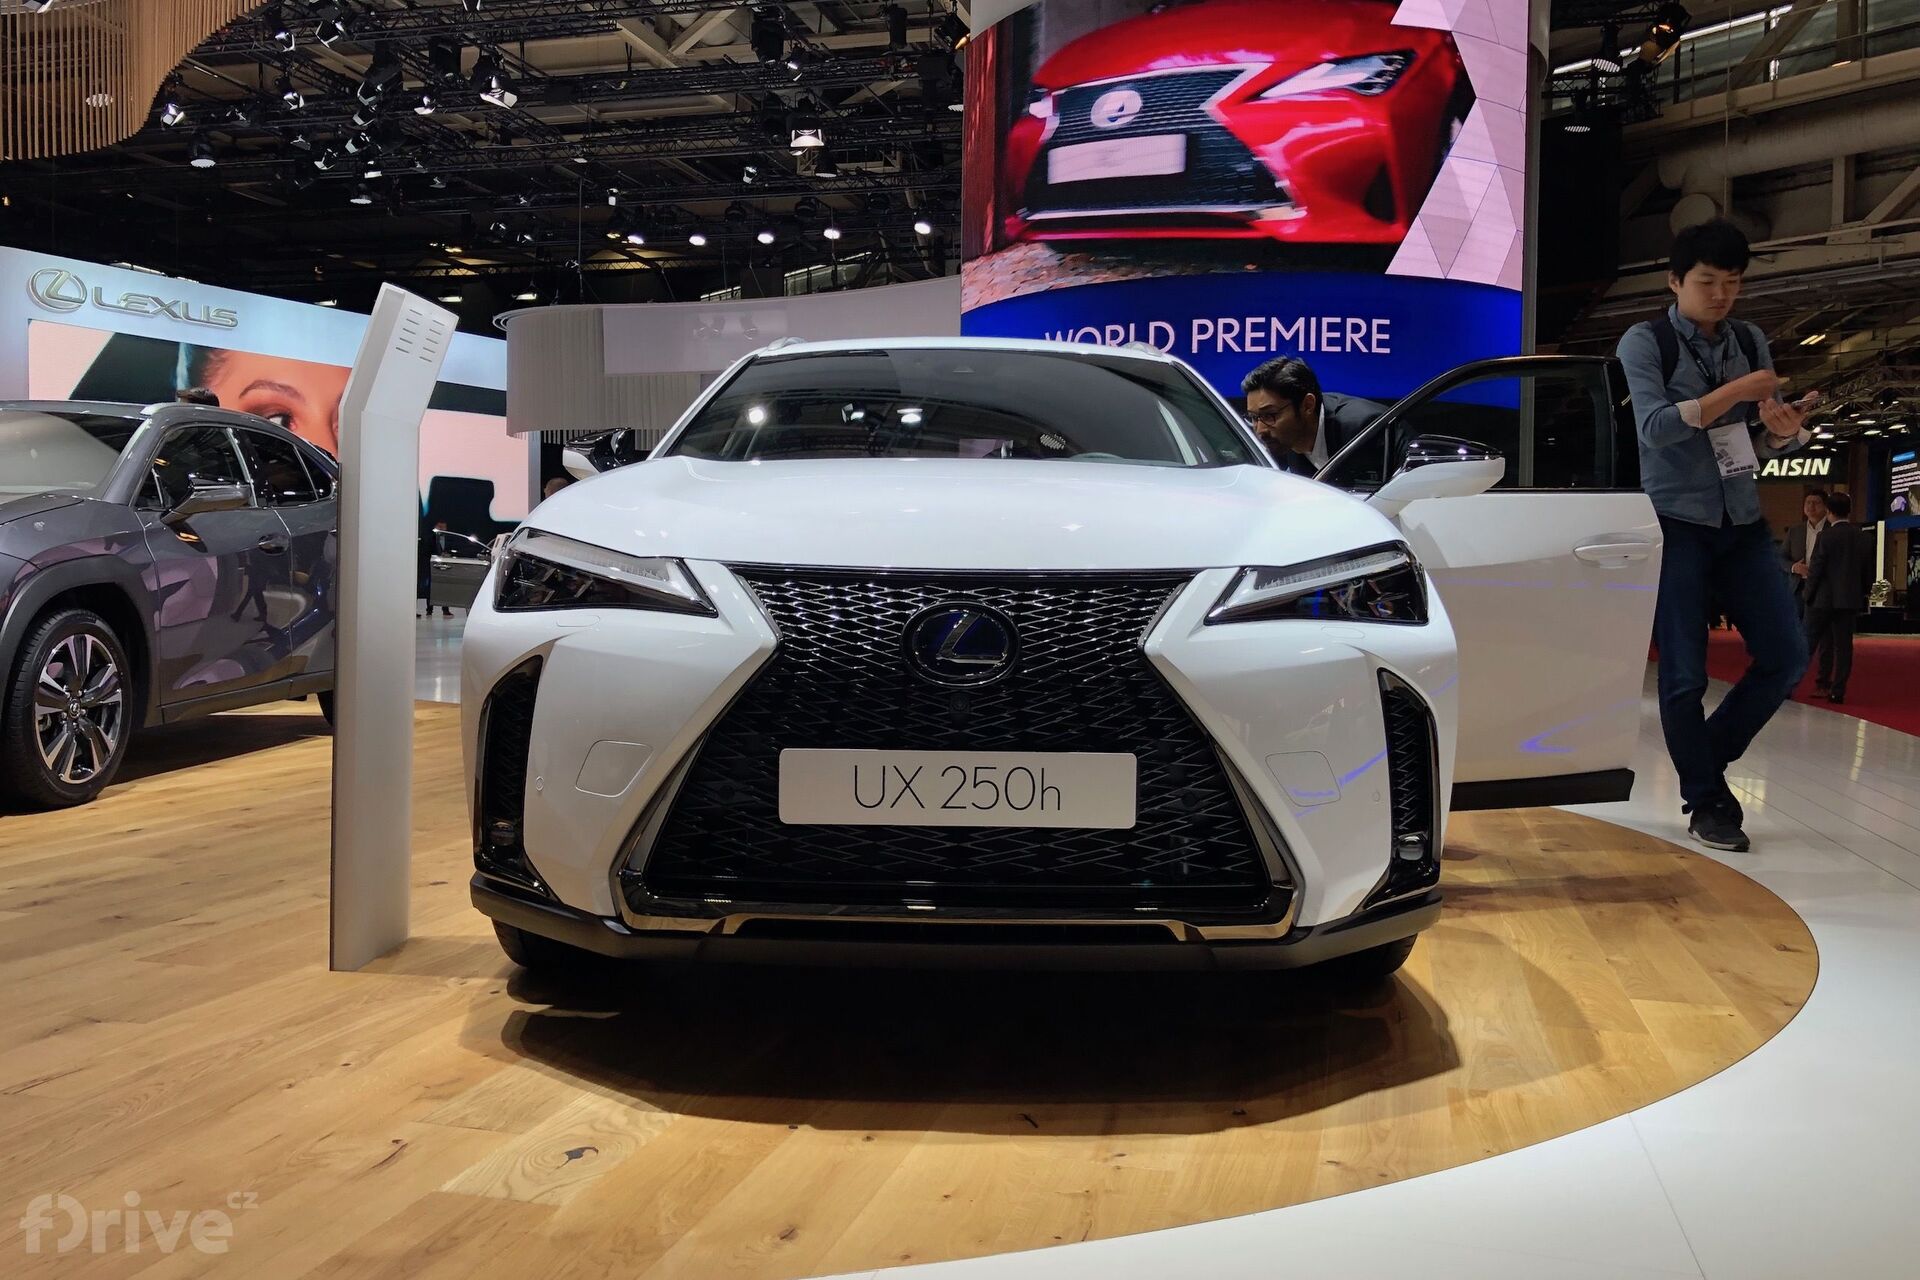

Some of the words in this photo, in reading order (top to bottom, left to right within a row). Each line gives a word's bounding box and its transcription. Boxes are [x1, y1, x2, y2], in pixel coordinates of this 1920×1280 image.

[91, 286, 239, 328] LEXUS
[1191, 316, 1391, 354] PREMIERE
[1761, 458, 1831, 476] AISIN
[853, 765, 925, 809] UX
[940, 765, 1061, 811] 250h
